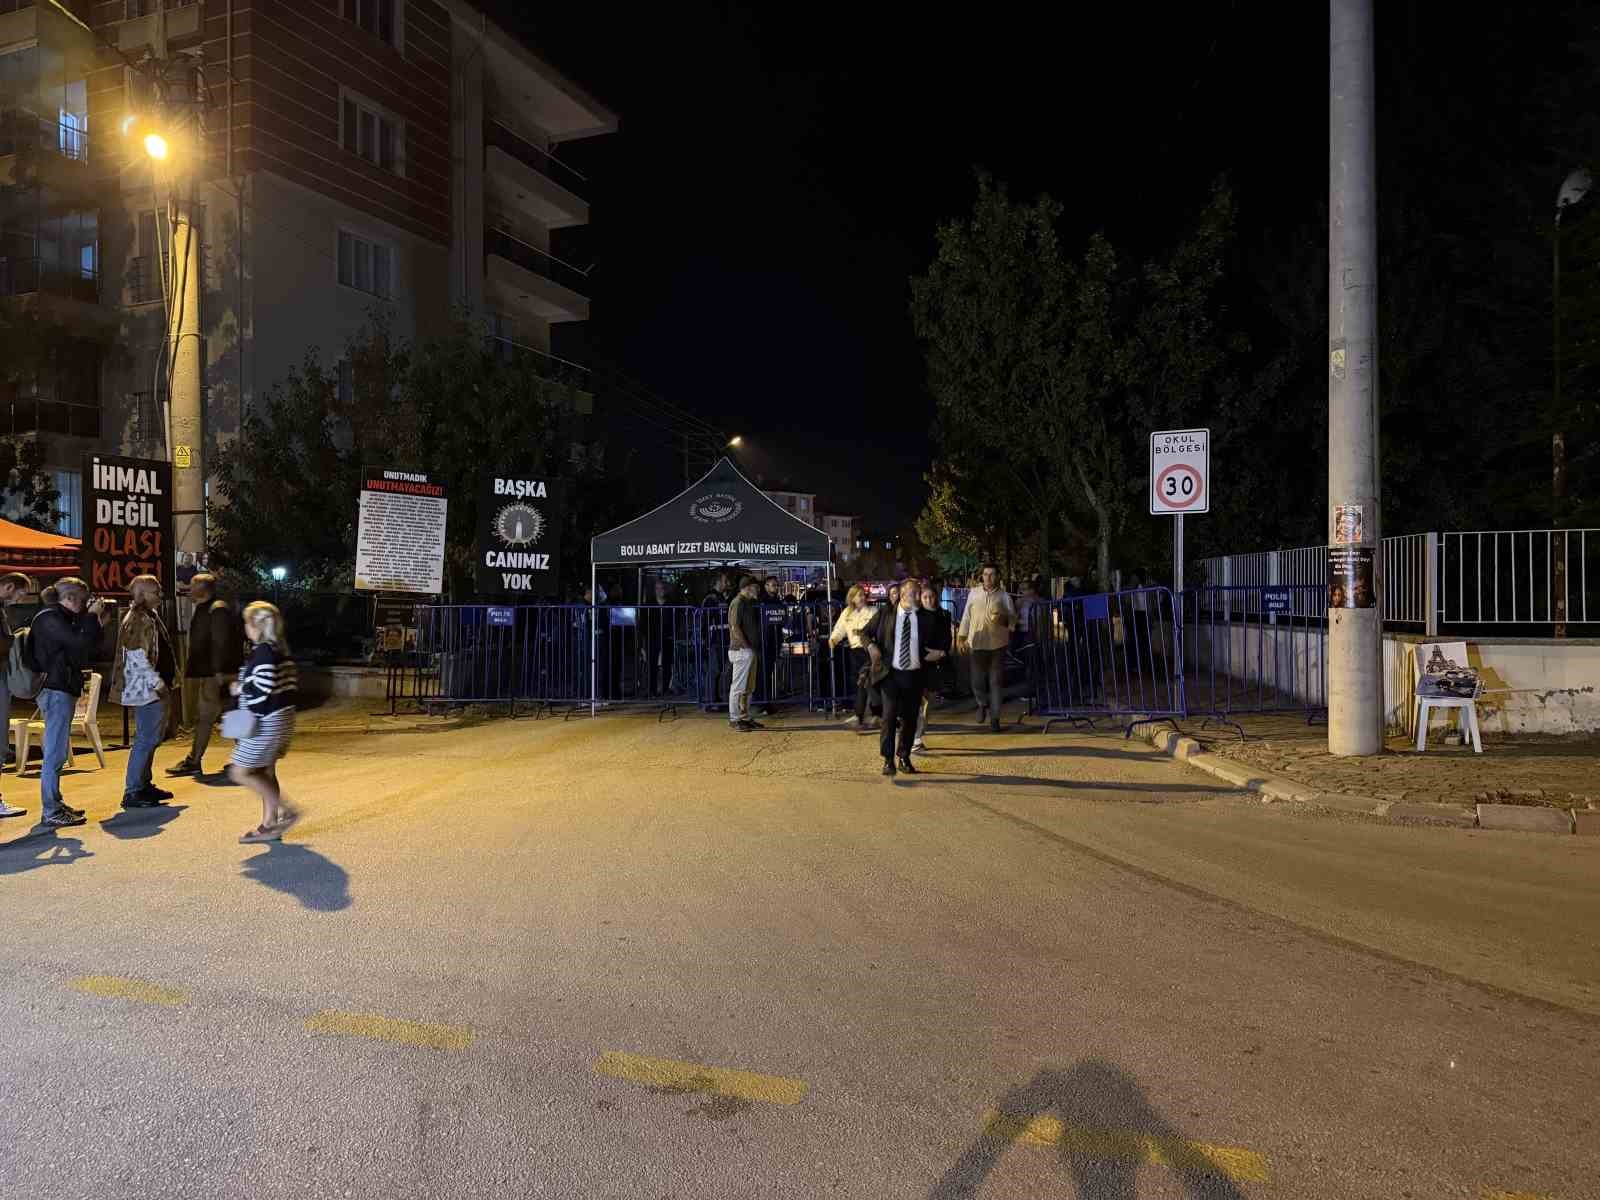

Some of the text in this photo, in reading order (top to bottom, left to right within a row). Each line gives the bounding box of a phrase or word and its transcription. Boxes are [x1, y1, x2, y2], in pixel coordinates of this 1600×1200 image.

[1165, 436, 1195, 446] OKUL
[92, 457, 162, 495] İHMAL
[1166, 476, 1194, 496] 30
[494, 478, 548, 499] BAŞKA
[96, 494, 160, 528] DEĞİL
[620, 545, 645, 557] BOLU
[646, 544, 675, 556] ABANT
[703, 541, 737, 554] BAYSAL
[485, 550, 550, 570] CANIMIZ
[501, 572, 532, 591] YOK
